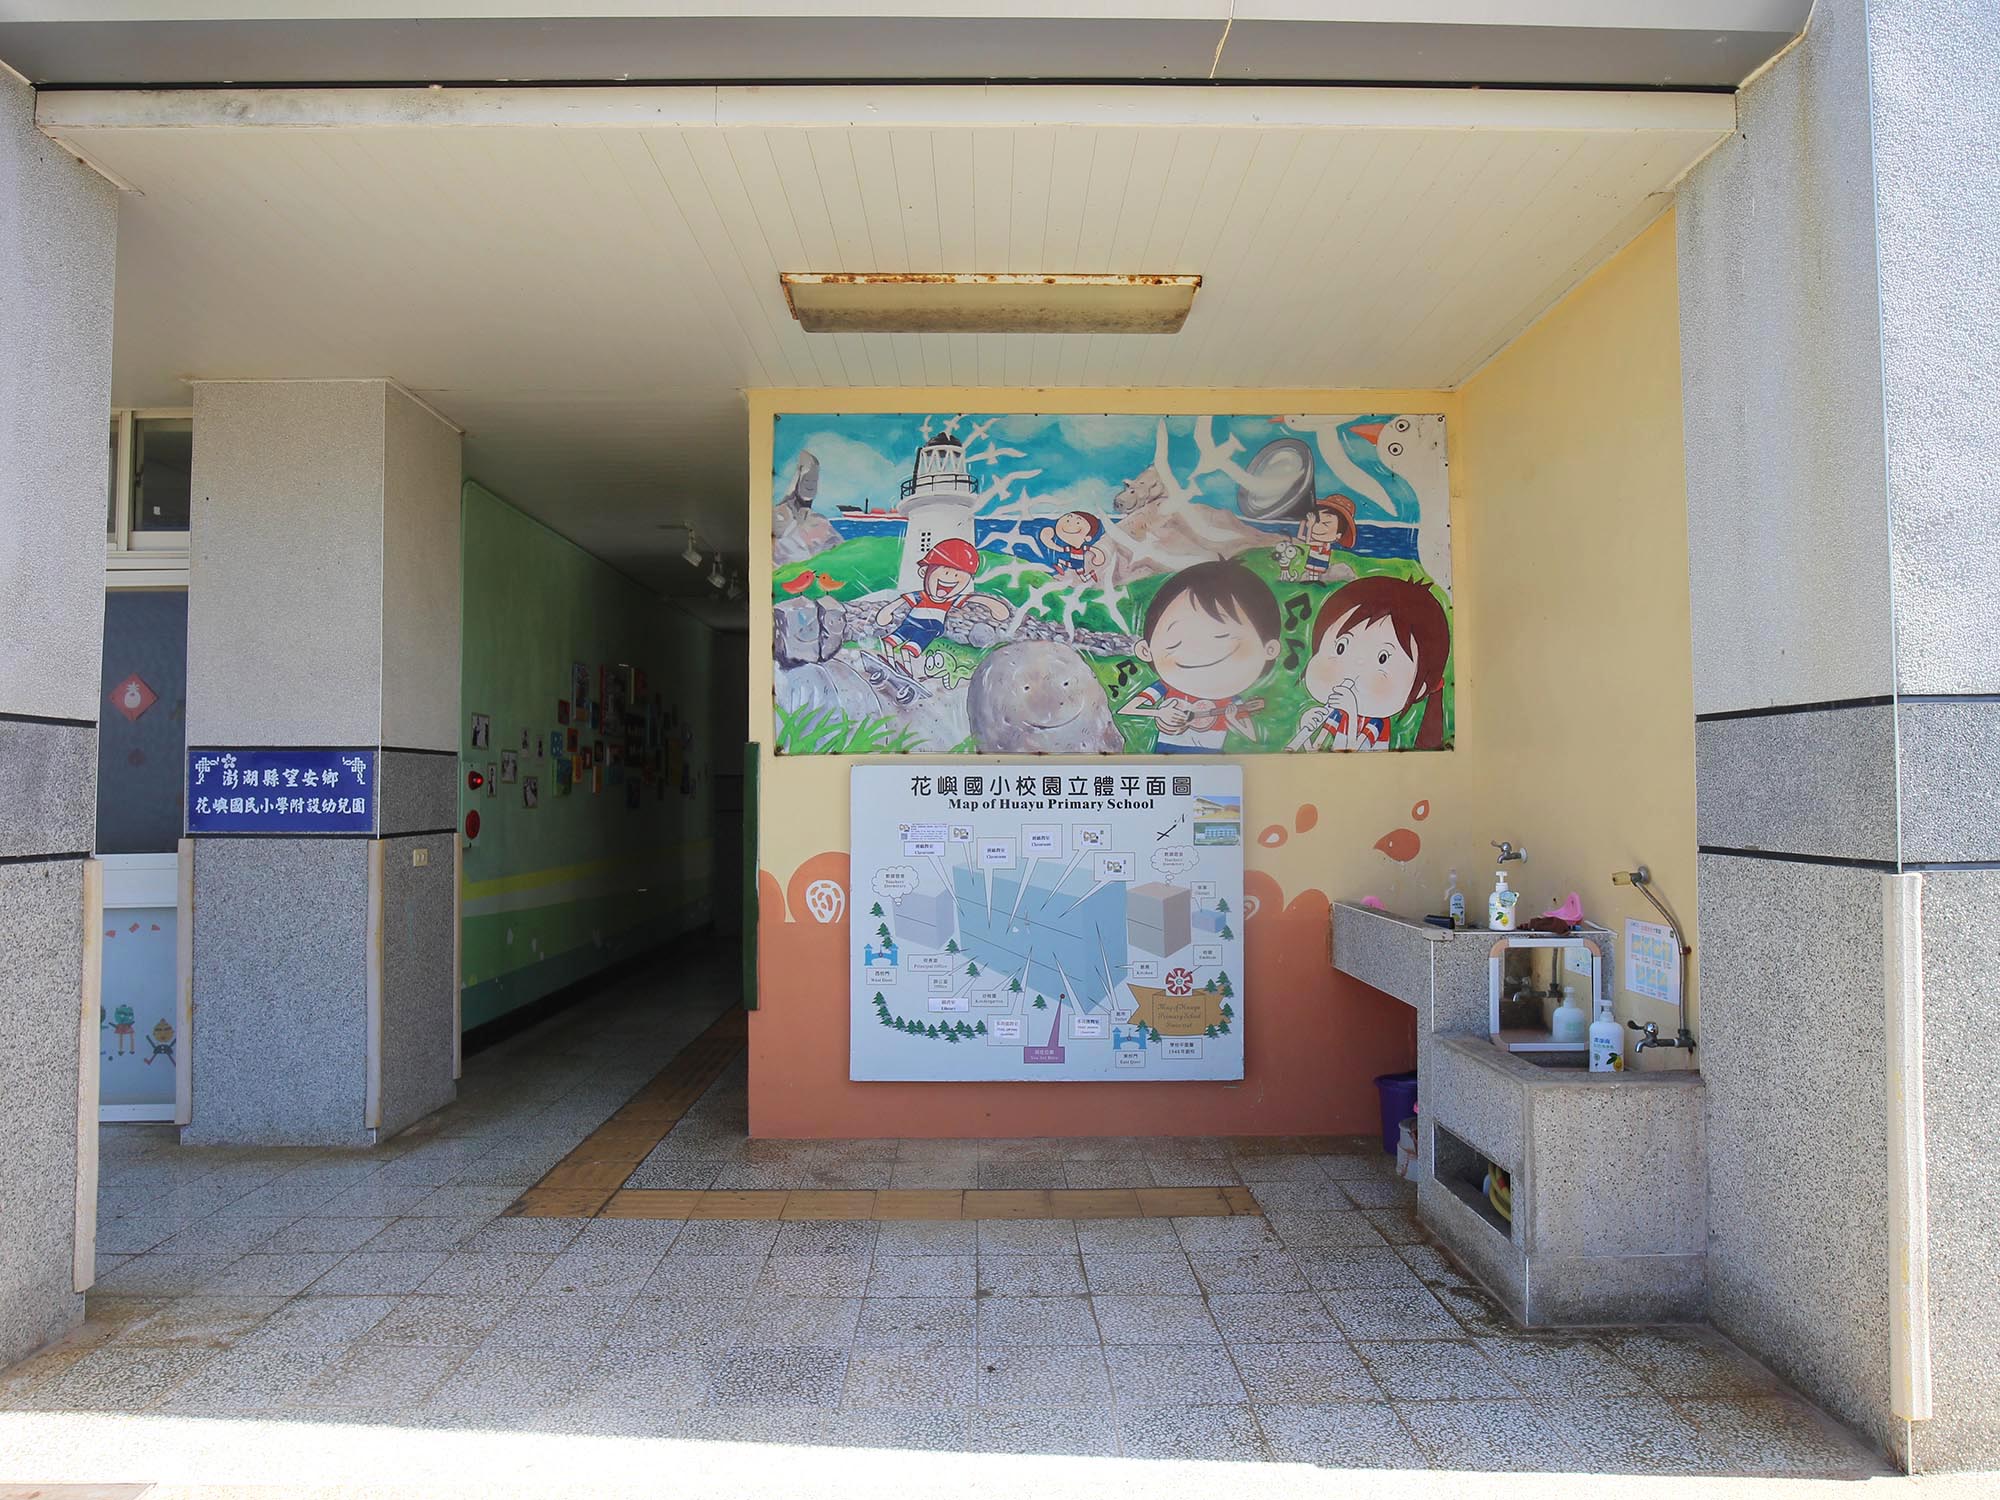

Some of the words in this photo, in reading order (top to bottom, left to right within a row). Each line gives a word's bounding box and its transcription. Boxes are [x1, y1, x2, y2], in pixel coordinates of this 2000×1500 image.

[222, 768, 339, 790] 澎湖縣望安鄉
[911, 775, 1192, 797] 花嶼國小校園立體平面圖
[195, 796, 366, 815] 花嶼國民小學附設幼兒園
[949, 799, 980, 812] Map
[983, 799, 997, 810] of
[1000, 799, 1044, 812] Huayu
[1048, 799, 1104, 812] Primary
[1107, 799, 1154, 810] School
